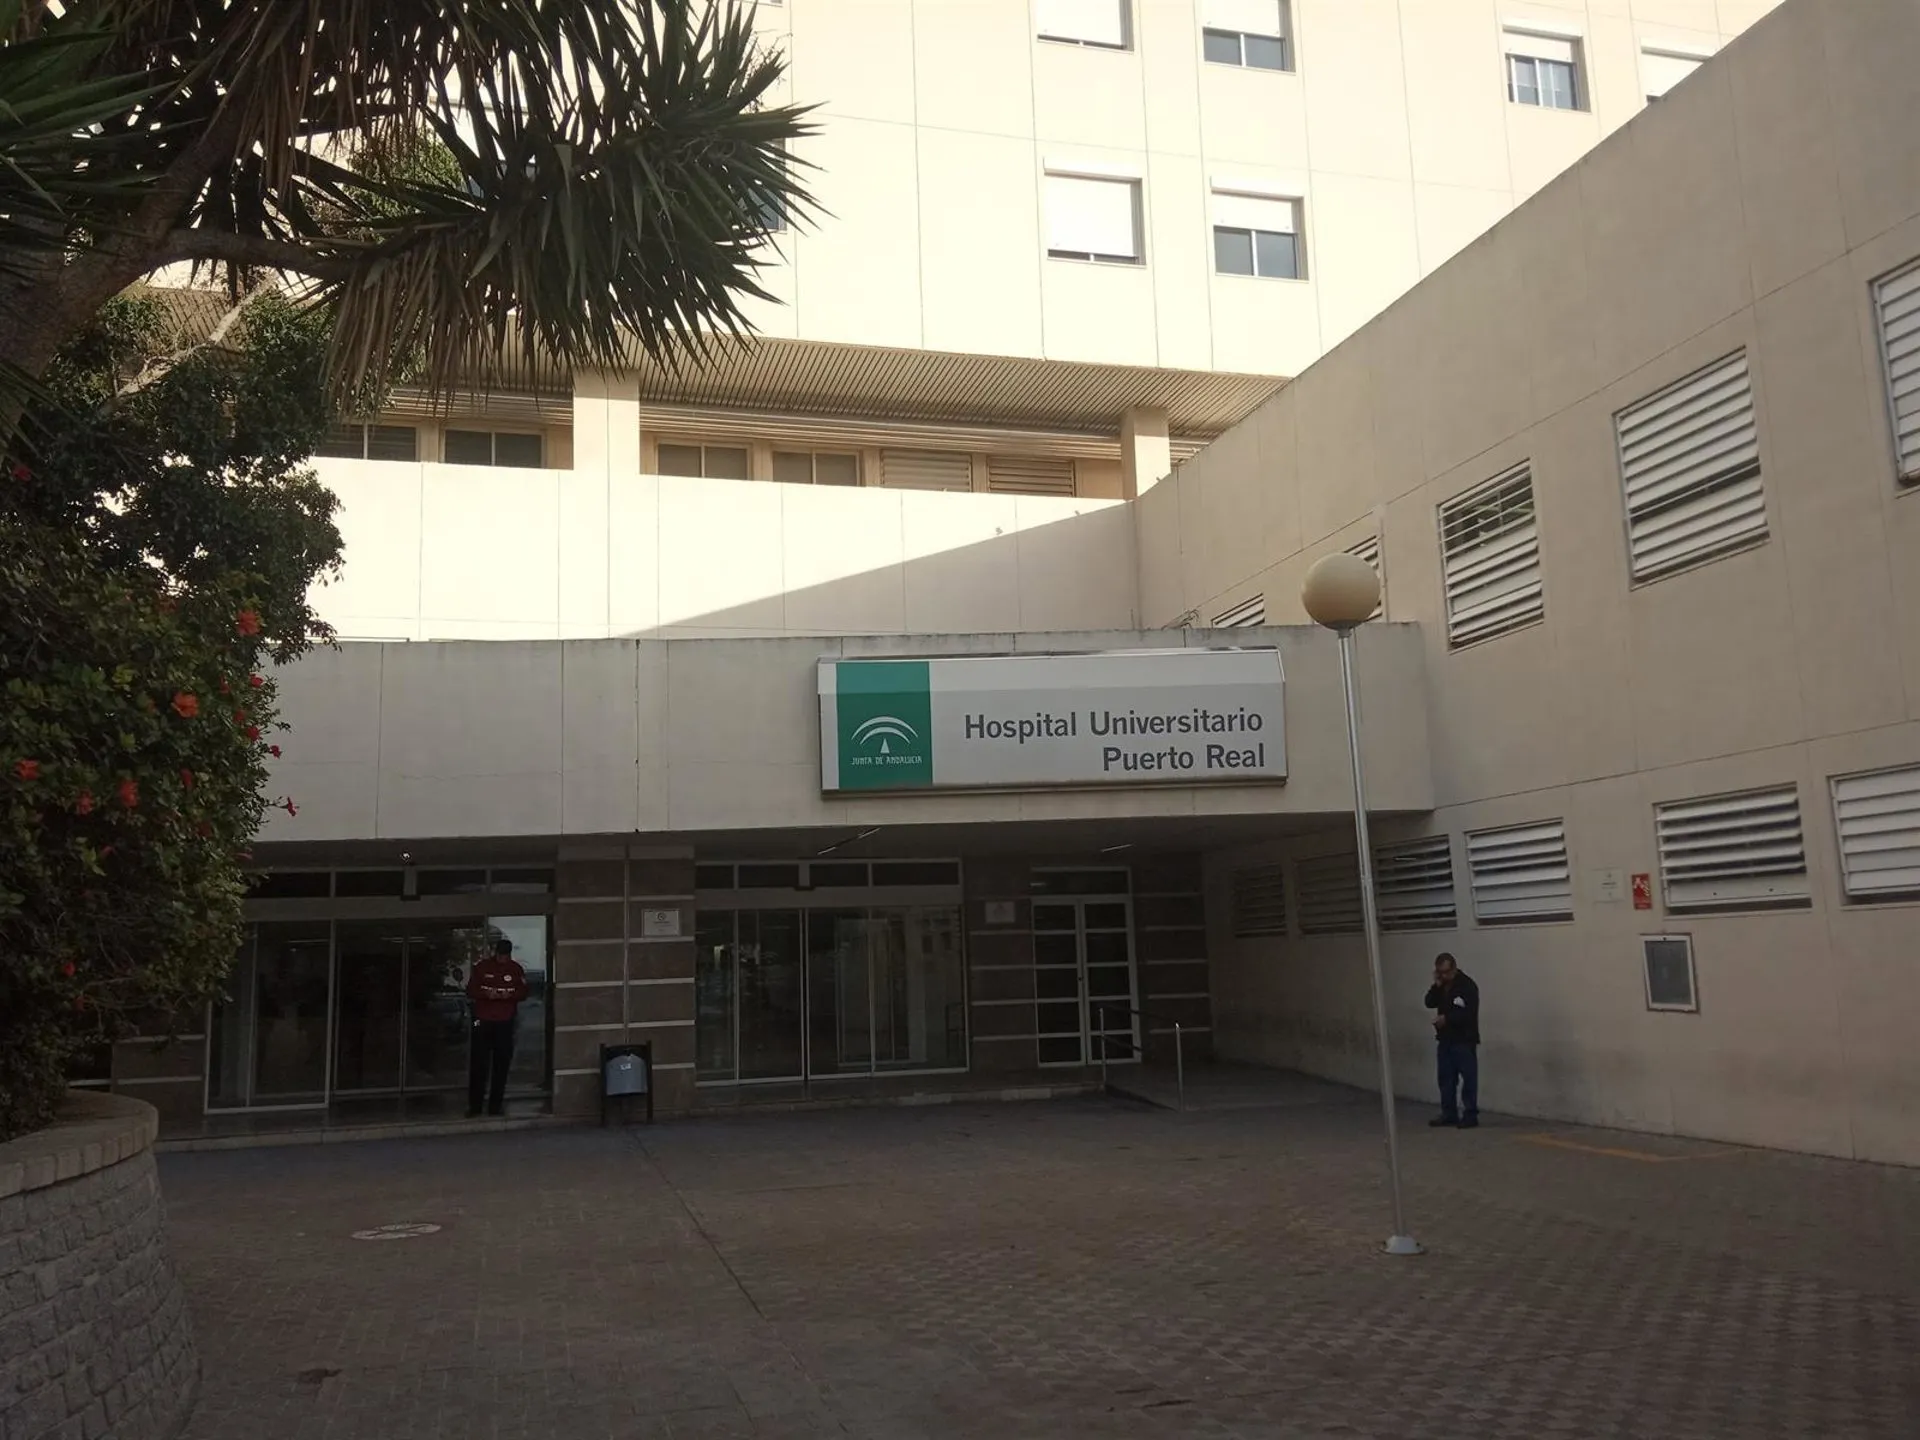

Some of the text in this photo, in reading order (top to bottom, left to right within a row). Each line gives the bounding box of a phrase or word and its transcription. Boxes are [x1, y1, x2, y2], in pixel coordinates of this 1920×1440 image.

[965, 707, 1262, 744] Hospital Universitario
[851, 757, 873, 766] JUNTA
[875, 755, 884, 765] DE
[1103, 743, 1265, 772] Puerto Real
